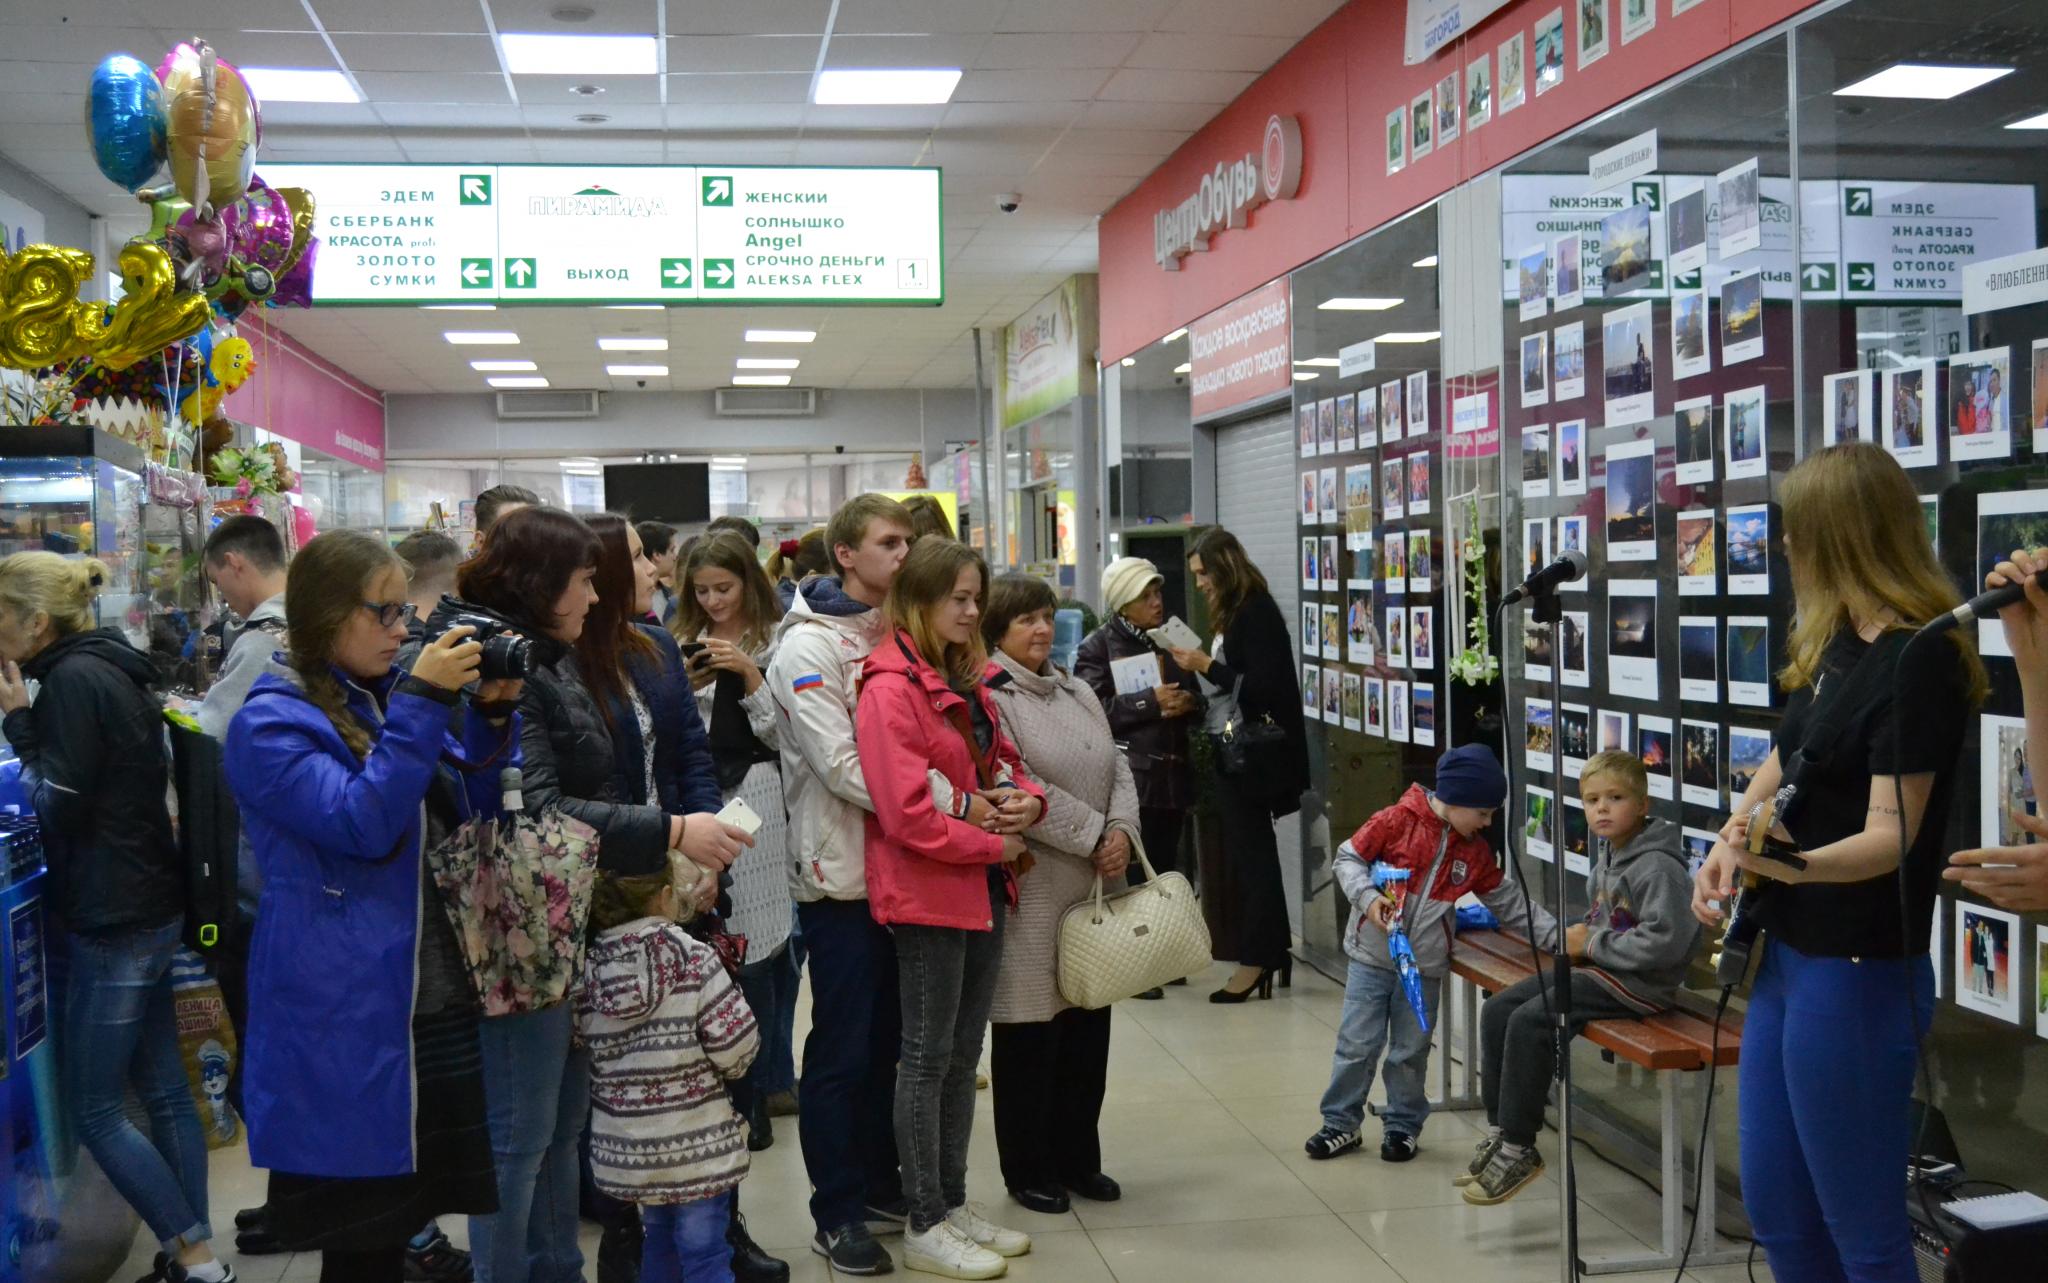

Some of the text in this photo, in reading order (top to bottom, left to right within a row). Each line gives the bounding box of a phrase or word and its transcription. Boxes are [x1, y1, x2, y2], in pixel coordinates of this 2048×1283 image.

[380, 190, 435, 204] ЭДЕМ
[528, 195, 668, 218] ПИРАМИДА
[329, 215, 435, 228] СБЕРБАНК
[745, 217, 845, 229] СОЛНЫШКО
[328, 235, 404, 248] КРАСОТА
[745, 233, 802, 251] Angel
[356, 255, 435, 267] ЗОЛОТО
[745, 255, 885, 269] СРОЧНО ДЕНЬГИ
[566, 268, 630, 281] ВЫХОД
[907, 262, 916, 280] 1
[369, 274, 436, 287] СУМКИ
[746, 274, 863, 286] ALEKSA FLEX
[1986, 264, 2048, 292] «ВЛЮБЛЕНН
